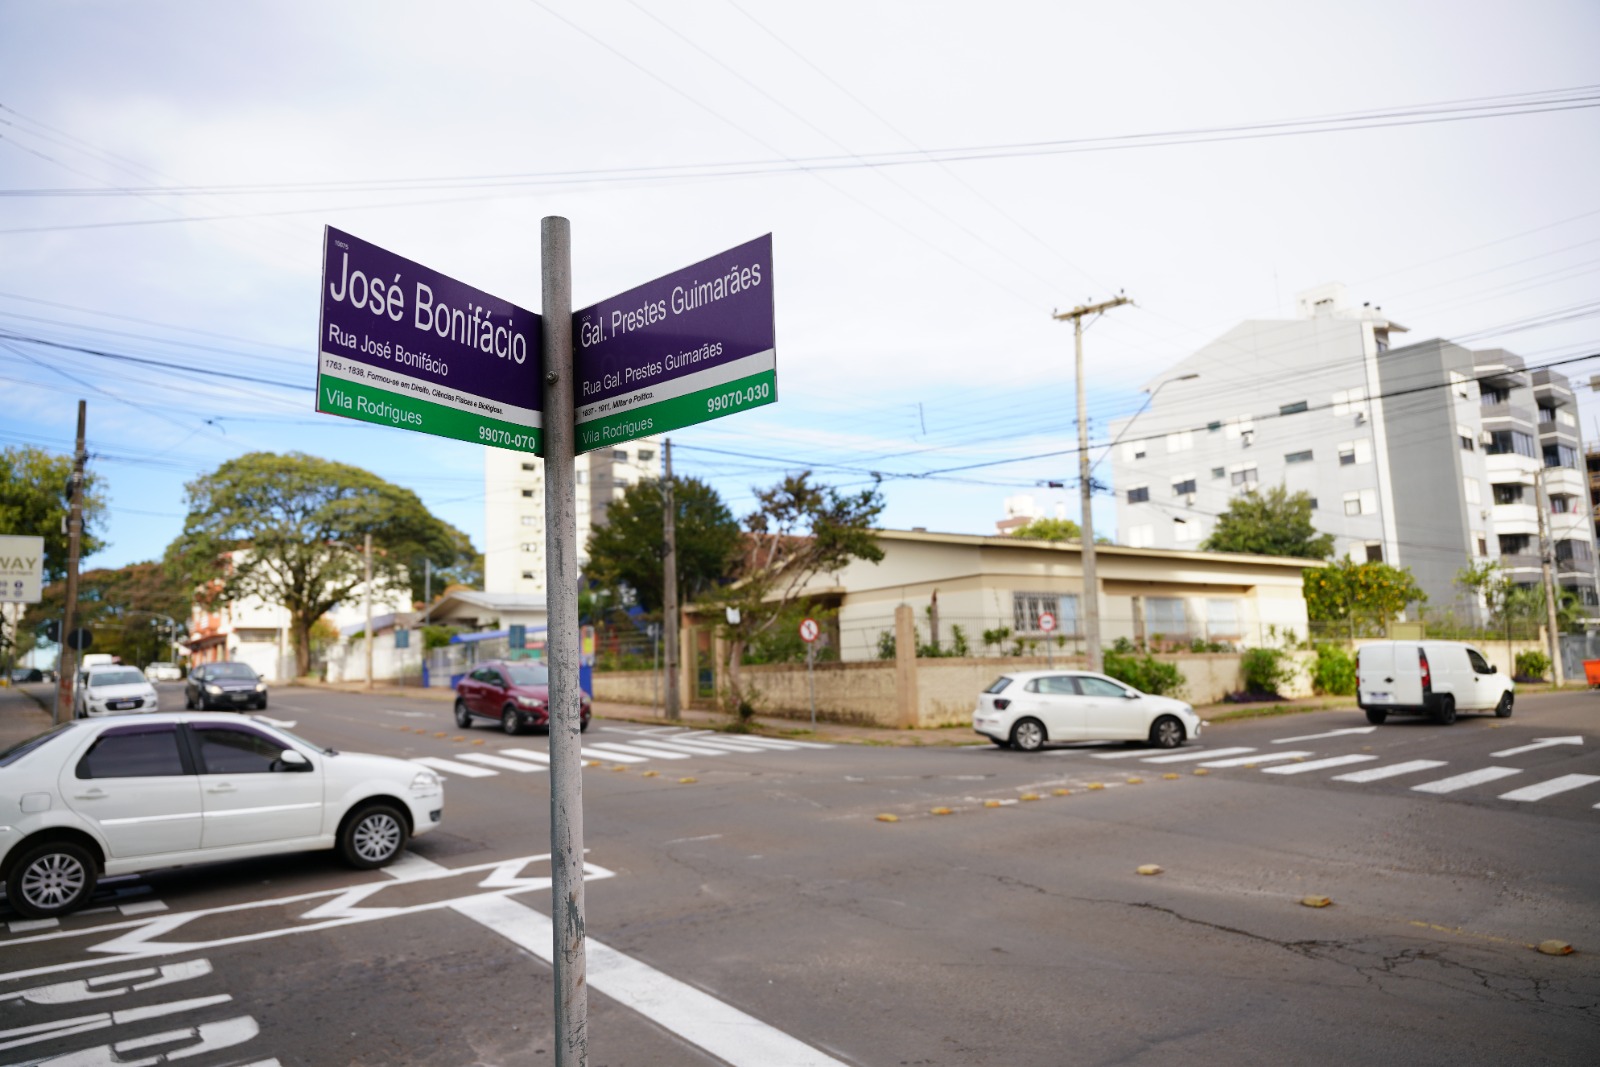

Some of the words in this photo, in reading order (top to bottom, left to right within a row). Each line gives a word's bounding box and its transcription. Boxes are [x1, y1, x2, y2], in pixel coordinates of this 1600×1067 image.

[330, 253, 404, 322] José
[414, 281, 526, 364] Bonifácio
[581, 316, 607, 348] Gal.
[612, 300, 666, 338] Prestes
[671, 263, 762, 315] Guimarães
[328, 324, 356, 350] Rua
[360, 335, 391, 360] José
[395, 346, 448, 376] Bonifácio
[325, 360, 342, 370] 1763
[367, 371, 400, 386] Formou-se
[582, 380, 601, 396] Rua
[604, 370, 622, 390] Gal.
[625, 360, 662, 384] Prestes
[665, 342, 723, 369] Guimarães
[326, 388, 352, 410] Vila
[357, 395, 422, 425] Rodrigues
[707, 382, 770, 414] 99070-030
[478, 426, 536, 450] 99070-070
[582, 430, 600, 444] Vila
[602, 418, 654, 440] Rodrigues
